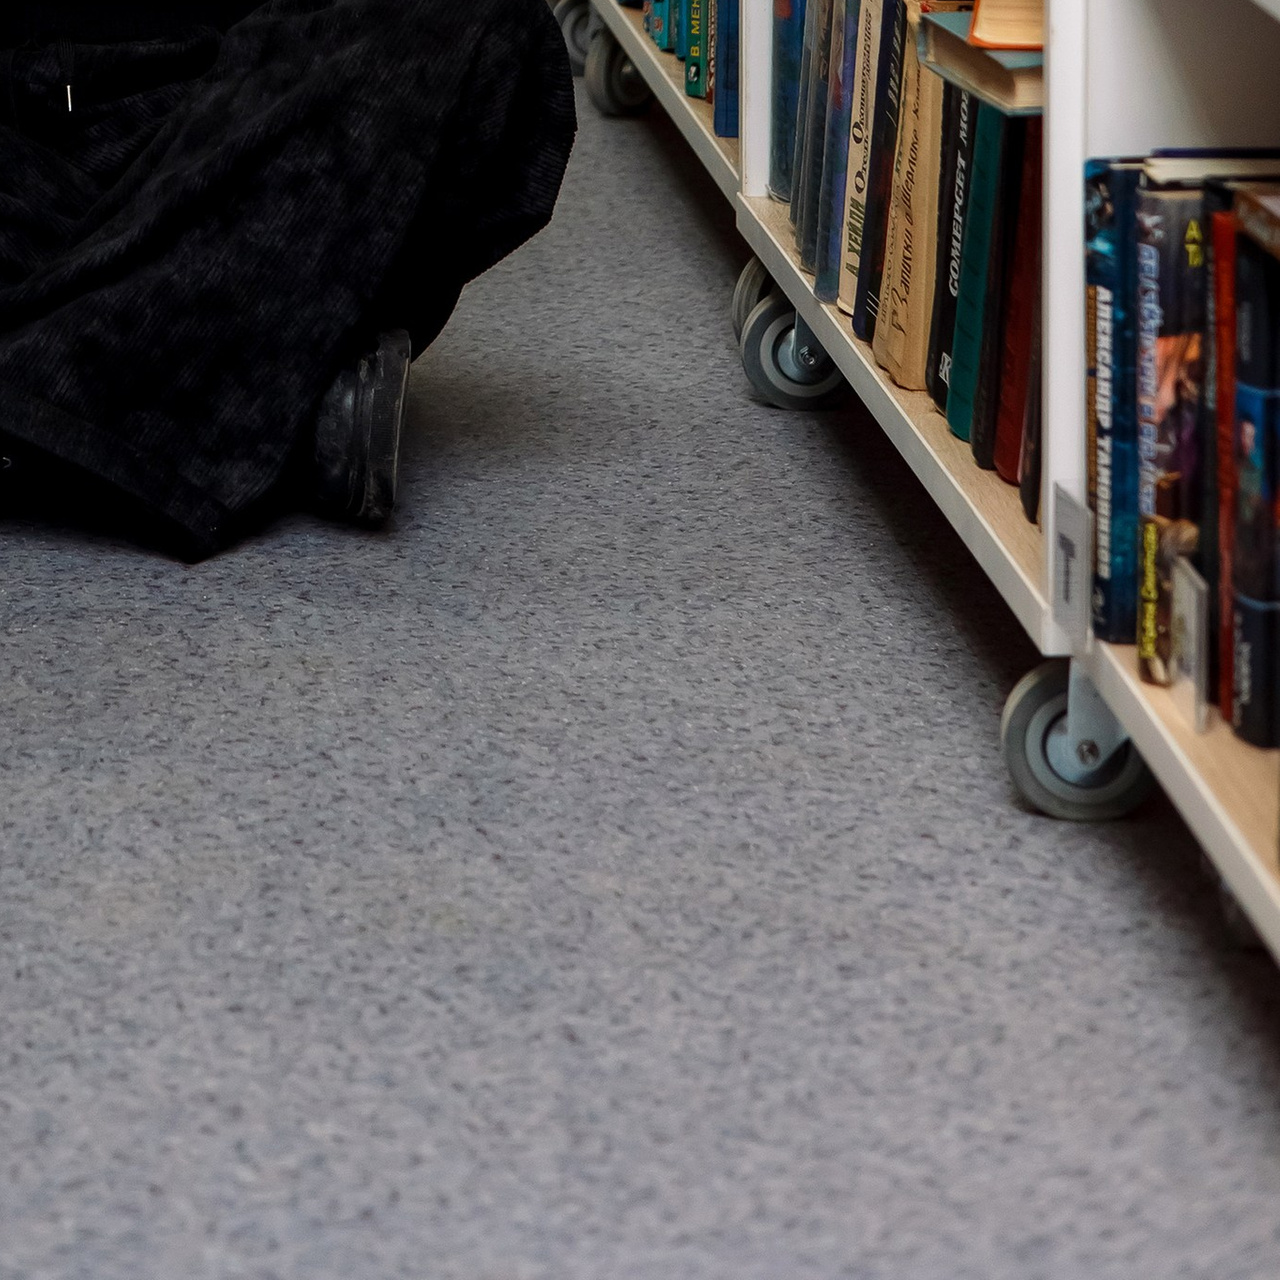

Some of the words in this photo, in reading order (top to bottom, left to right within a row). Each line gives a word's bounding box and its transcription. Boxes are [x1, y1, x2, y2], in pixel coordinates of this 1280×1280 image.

[690, 40, 700, 58] В.
[854, 134, 869, 194] Отель
[900, 128, 919, 210] Шерлоке
[846, 196, 865, 258] ХЕЙЛИ
[904, 212, 914, 226] о
[947, 149, 966, 298] СОМЕРСЕТ
[845, 262, 859, 278] А
[891, 228, 913, 309] Записки
[1095, 285, 1114, 430] АЛЕКСАНДР
